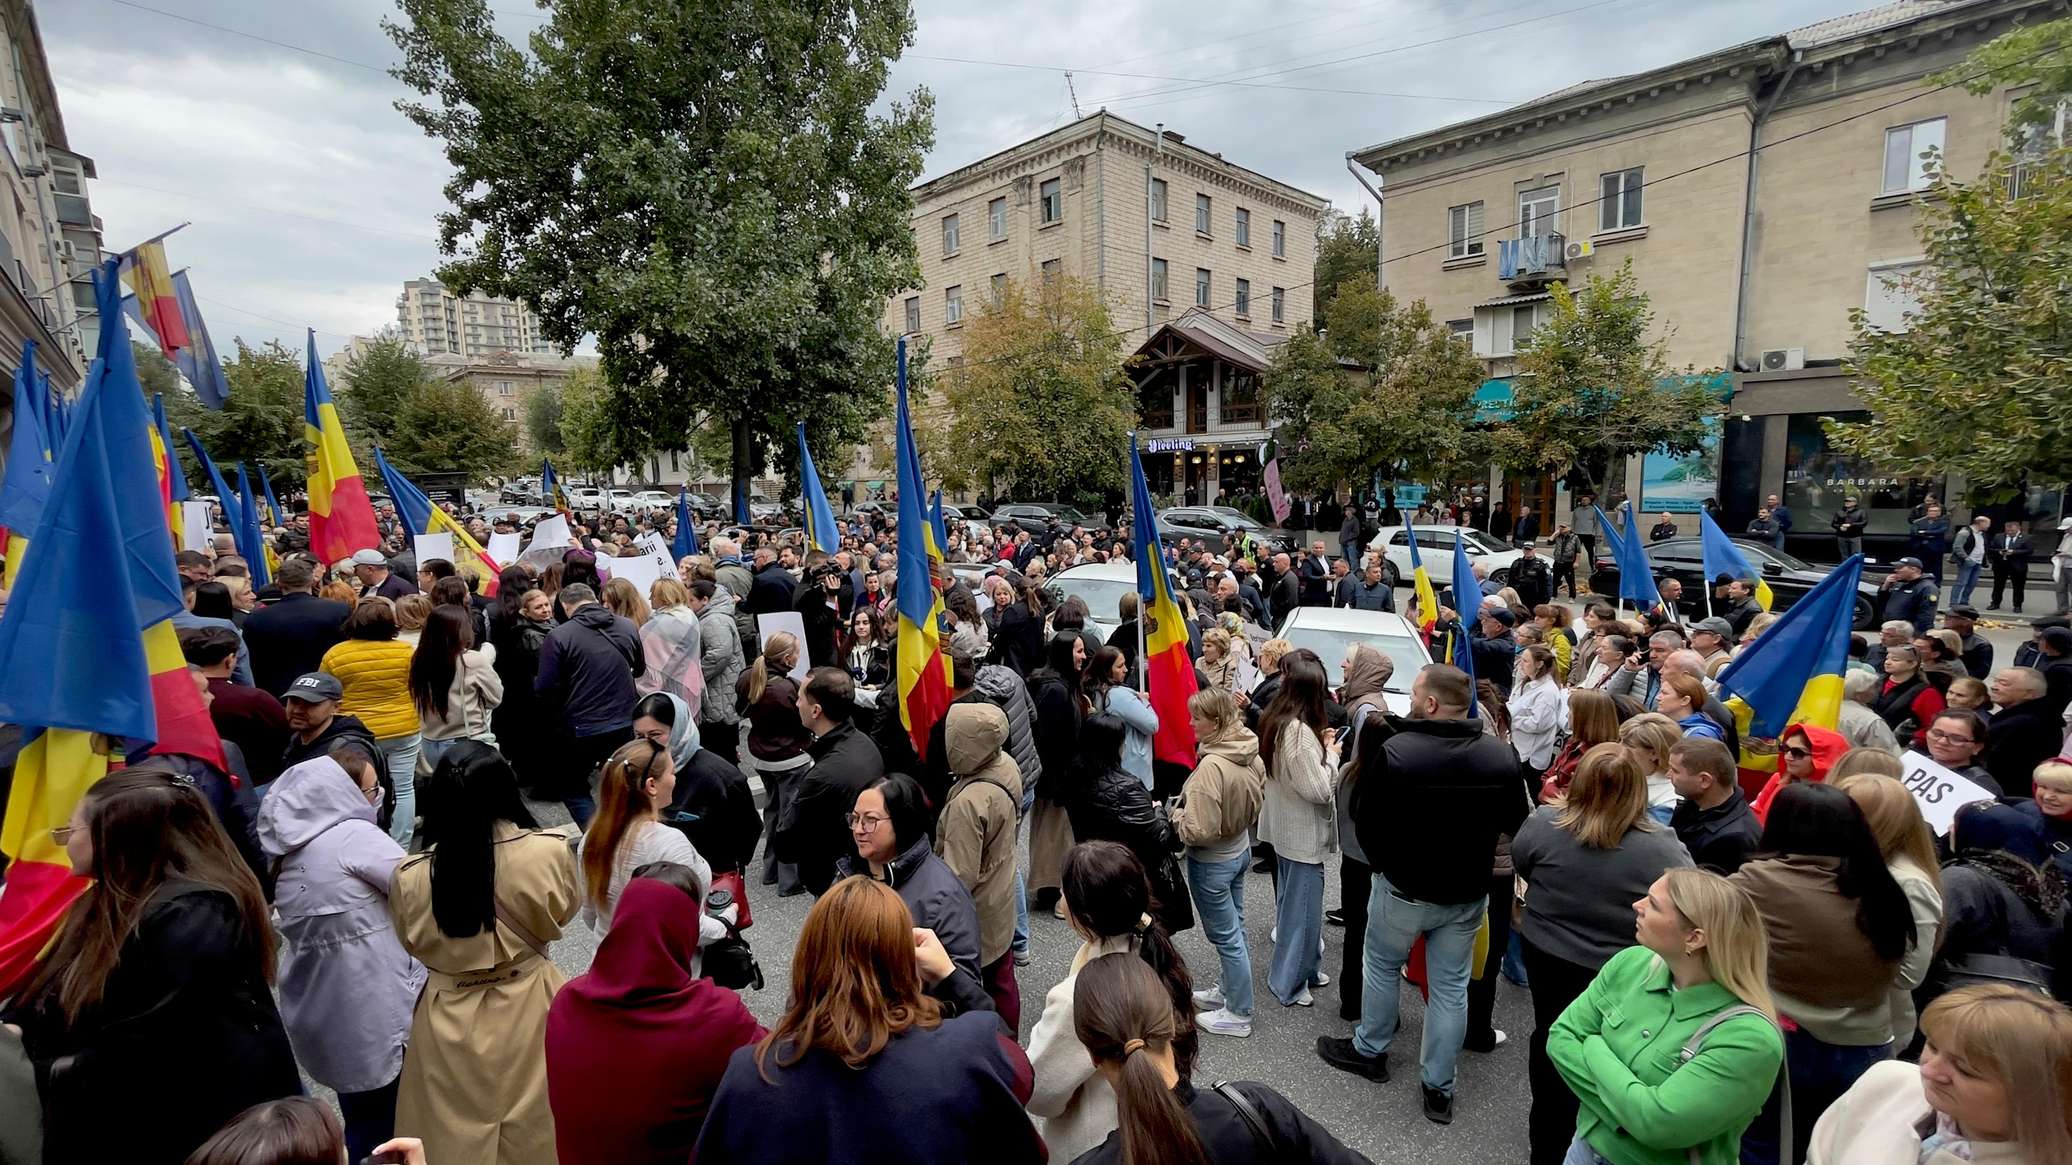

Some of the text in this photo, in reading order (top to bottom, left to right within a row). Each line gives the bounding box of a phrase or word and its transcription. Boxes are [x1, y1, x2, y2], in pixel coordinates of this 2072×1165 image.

[1826, 478, 1899, 487] BARBARA
[295, 677, 320, 688] FBI
[1903, 767, 1955, 804] PAS
